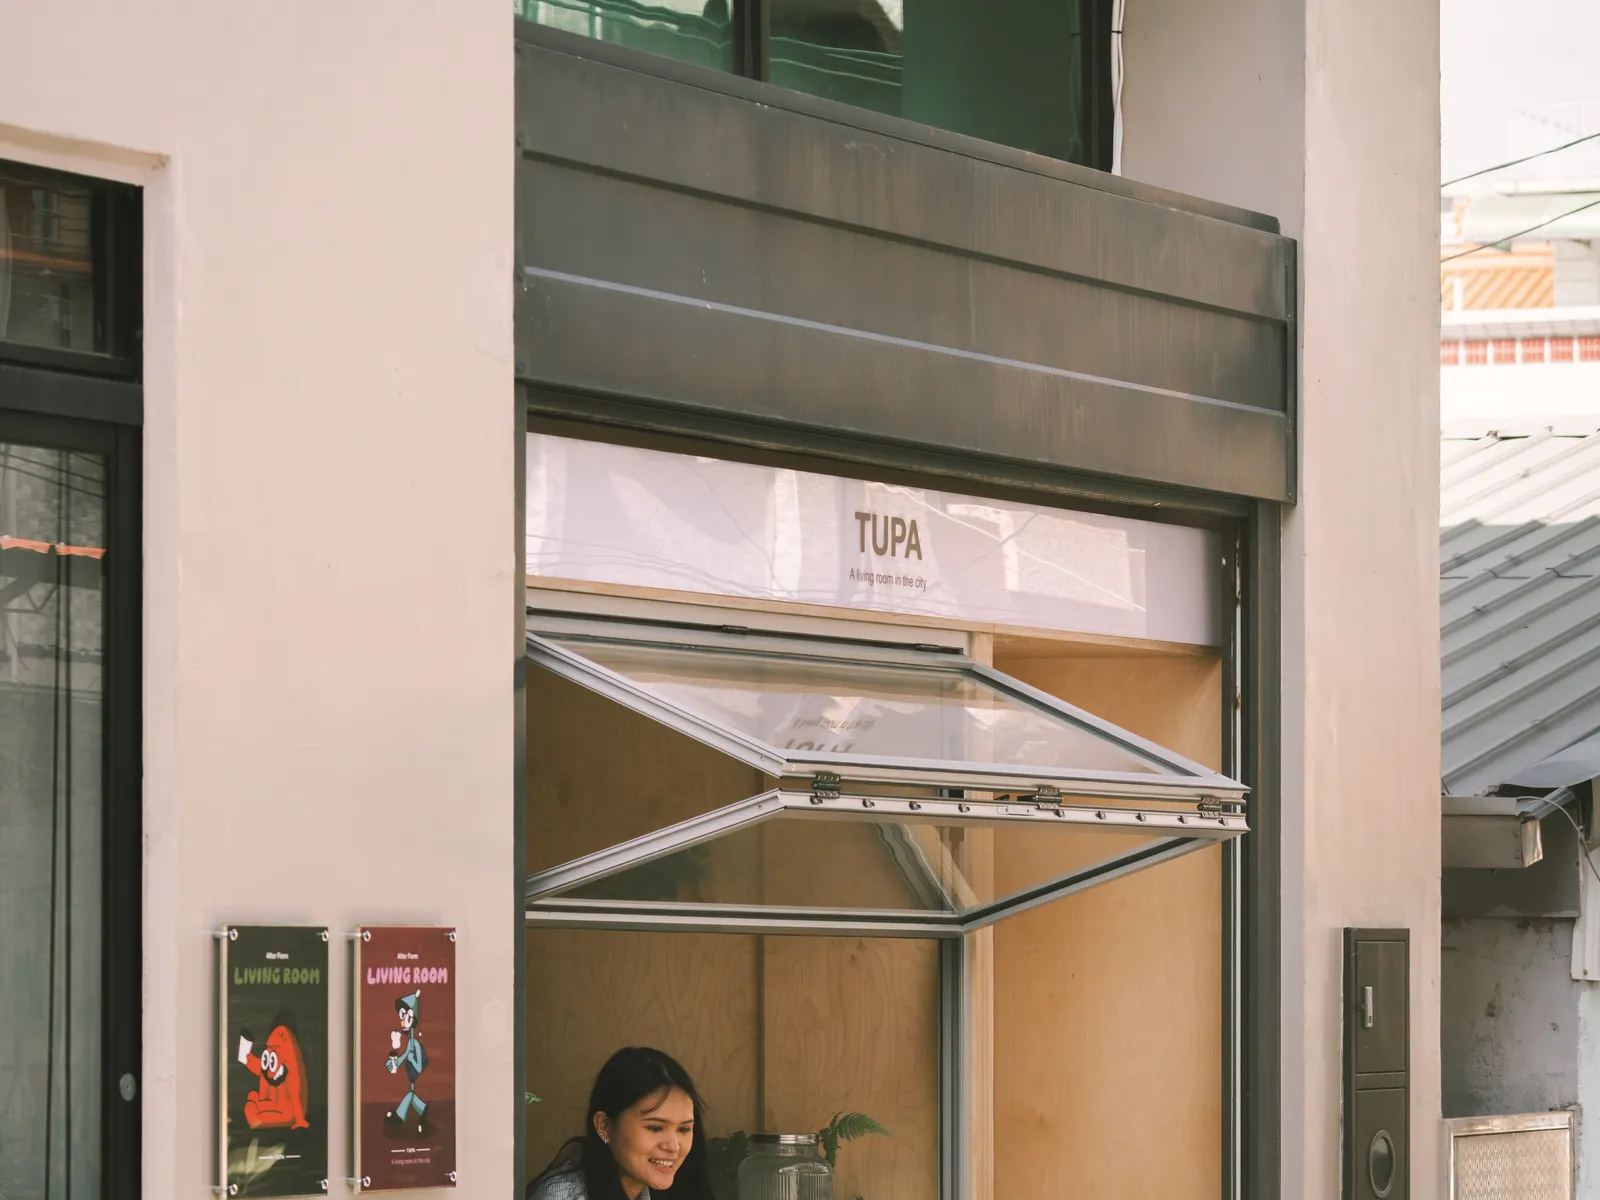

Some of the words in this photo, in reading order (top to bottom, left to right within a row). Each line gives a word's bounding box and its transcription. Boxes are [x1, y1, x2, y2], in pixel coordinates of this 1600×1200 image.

[855, 511, 922, 560] TUPA
[849, 567, 856, 580] A
[857, 569, 874, 586] living
[876, 573, 893, 585] room
[895, 573, 901, 586] in
[903, 575, 914, 588] the
[915, 576, 927, 592] city
[234, 966, 280, 985] LIVING
[283, 967, 320, 985] ROOM
[367, 966, 411, 985] LIVING
[413, 967, 448, 984] ROOM
